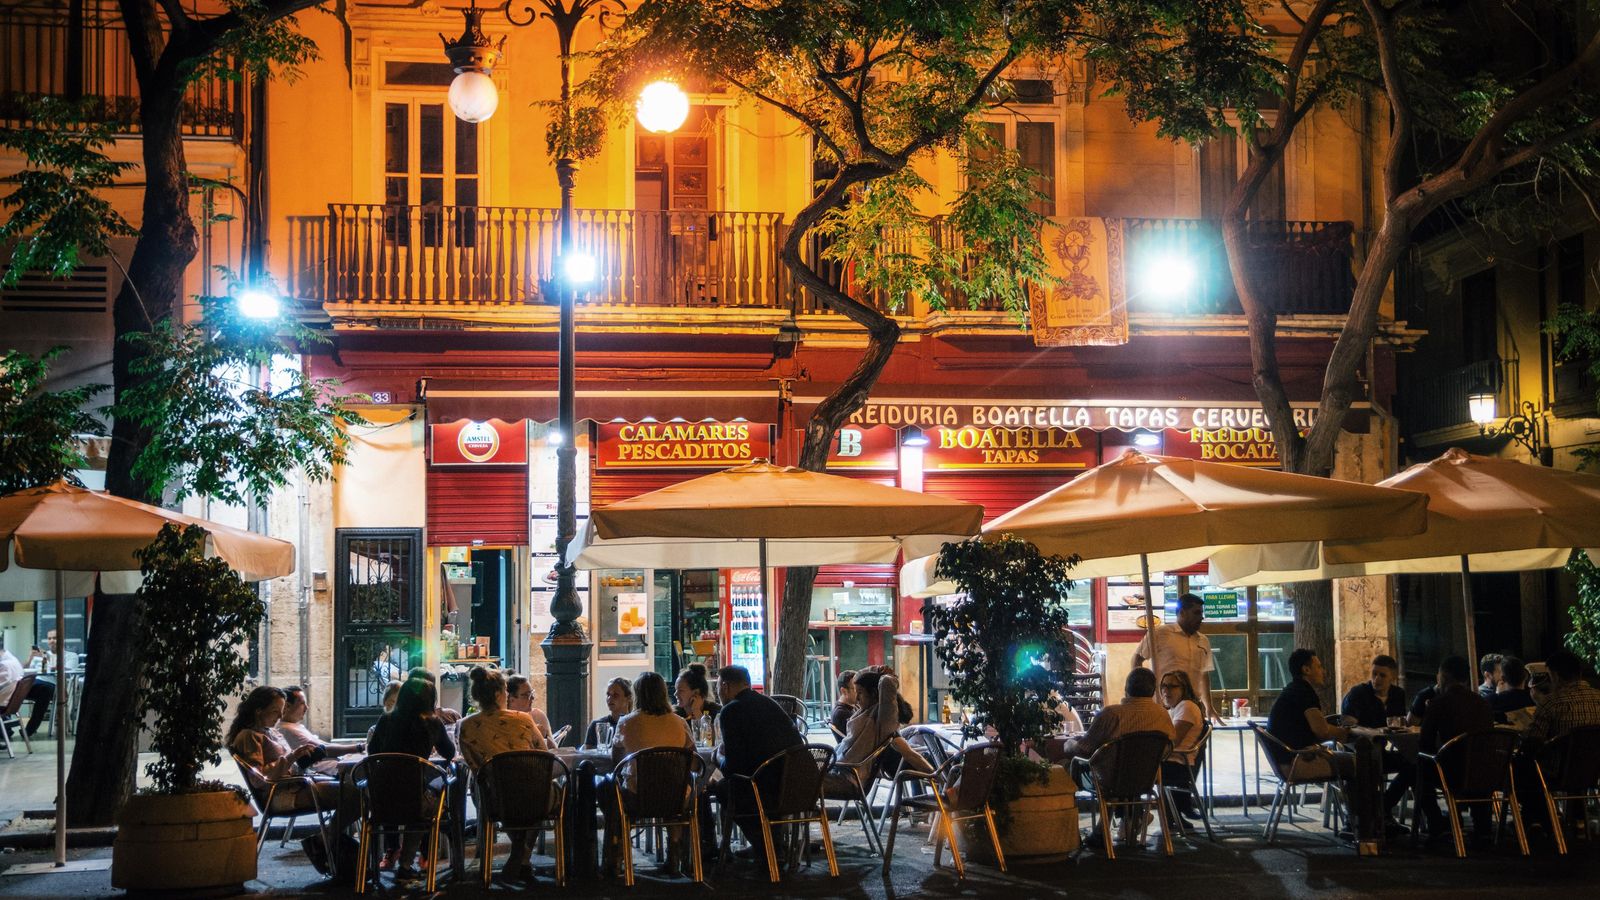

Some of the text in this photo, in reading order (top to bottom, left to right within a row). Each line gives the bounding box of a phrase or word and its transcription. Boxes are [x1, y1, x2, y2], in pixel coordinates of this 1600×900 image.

[374, 392, 389, 403] 33
[849, 405, 1314, 427] REIDURIA BOATELLA TAPAS CERVERI
[618, 424, 749, 442] CALAMARES
[938, 428, 1083, 449] BOATELLA
[617, 442, 752, 460] PESCADITOS
[981, 449, 1040, 464] TAPAS
